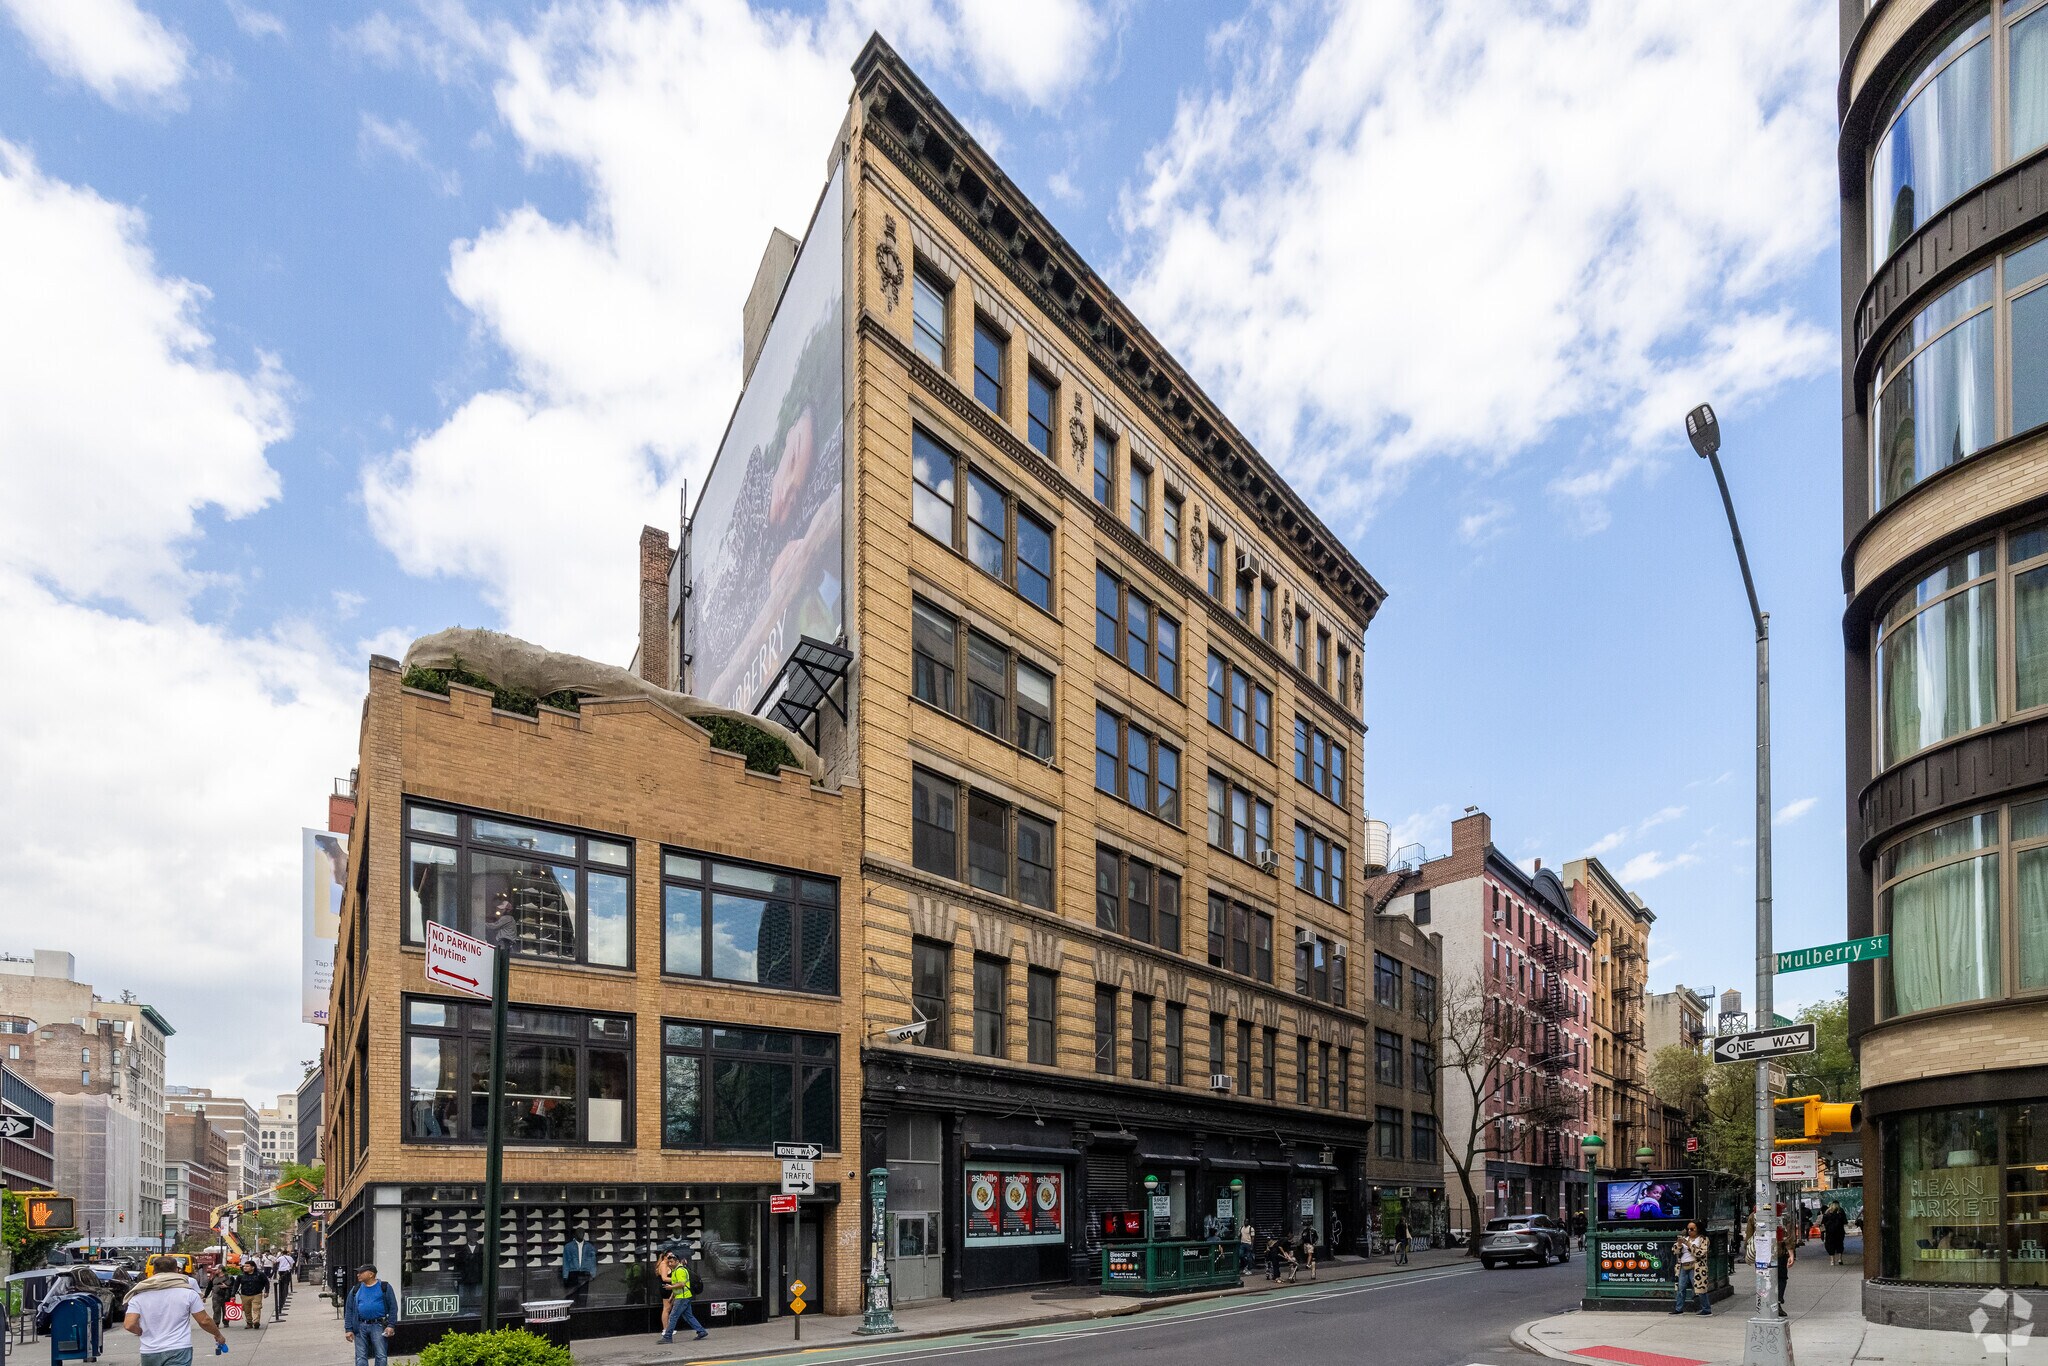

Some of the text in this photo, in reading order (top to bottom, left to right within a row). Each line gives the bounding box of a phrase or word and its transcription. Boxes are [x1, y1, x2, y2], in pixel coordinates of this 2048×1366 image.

[728, 608, 787, 711] RBERRY
[432, 929, 482, 956] NO PARKING
[432, 943, 467, 963] Anytime
[1780, 938, 1883, 969] Mulberry St
[1727, 1033, 1805, 1054] ONE WAY
[791, 1163, 806, 1171] ALL
[1910, 1196, 2000, 1217] ARKET
[1601, 1242, 1658, 1250] Bleecker St
[1601, 1250, 1635, 1259] Station
[409, 1297, 457, 1314] KITH
